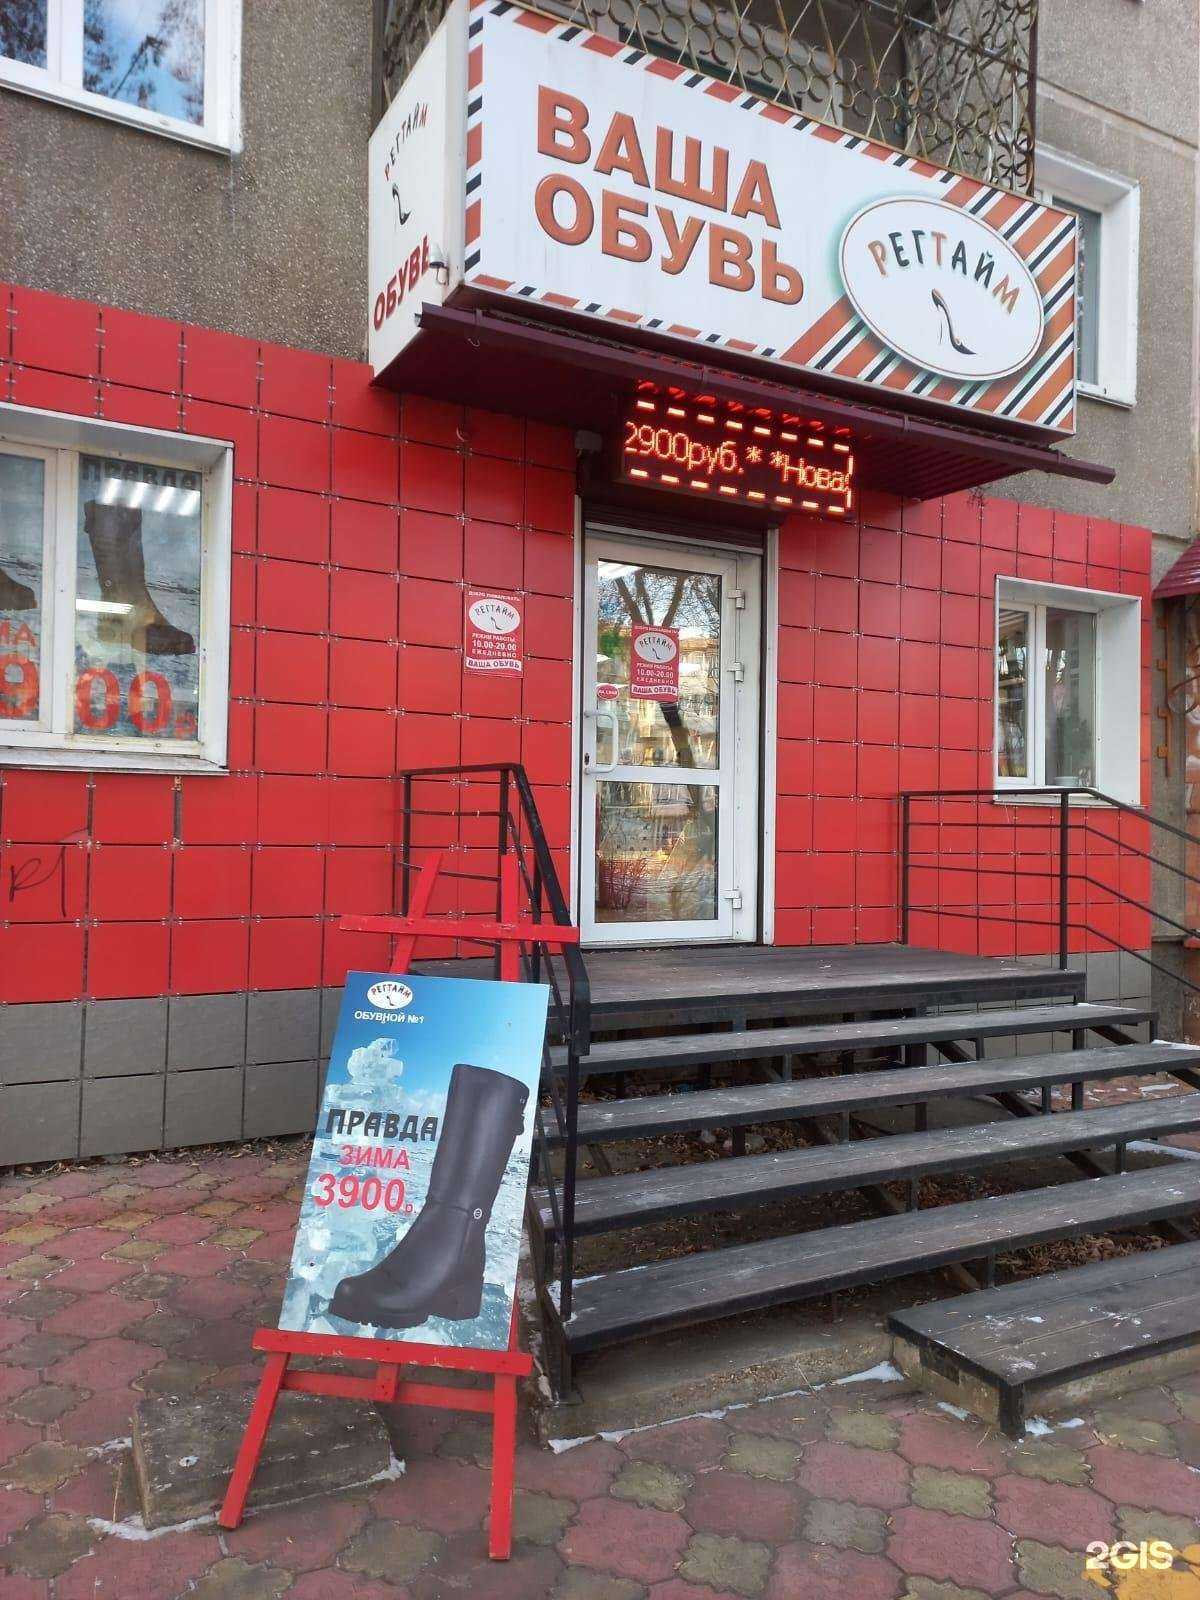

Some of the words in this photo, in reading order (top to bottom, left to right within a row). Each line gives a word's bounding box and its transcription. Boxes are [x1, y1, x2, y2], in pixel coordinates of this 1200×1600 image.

[384, 101, 429, 182] РЕГТАЙМ
[537, 84, 782, 231] ВАША
[535, 172, 805, 307] ОБУВЬ
[867, 229, 1021, 315] РЕГТАЙМ
[624, 420, 745, 476] 2900руб.
[474, 604, 515, 620] РЕГТАЙМ
[472, 639, 517, 651] 10.00-20.00
[468, 659, 491, 668] ВАША
[493, 660, 520, 669] ОБУВЬ
[633, 686, 653, 694] ВАША
[371, 983, 412, 999] РЕГТАЙМ
[354, 1010, 405, 1023] ОБУВНОЙ
[407, 1014, 424, 1025] №1
[325, 1108, 439, 1143] ПРАВДА
[338, 1144, 411, 1170] ЗИМА
